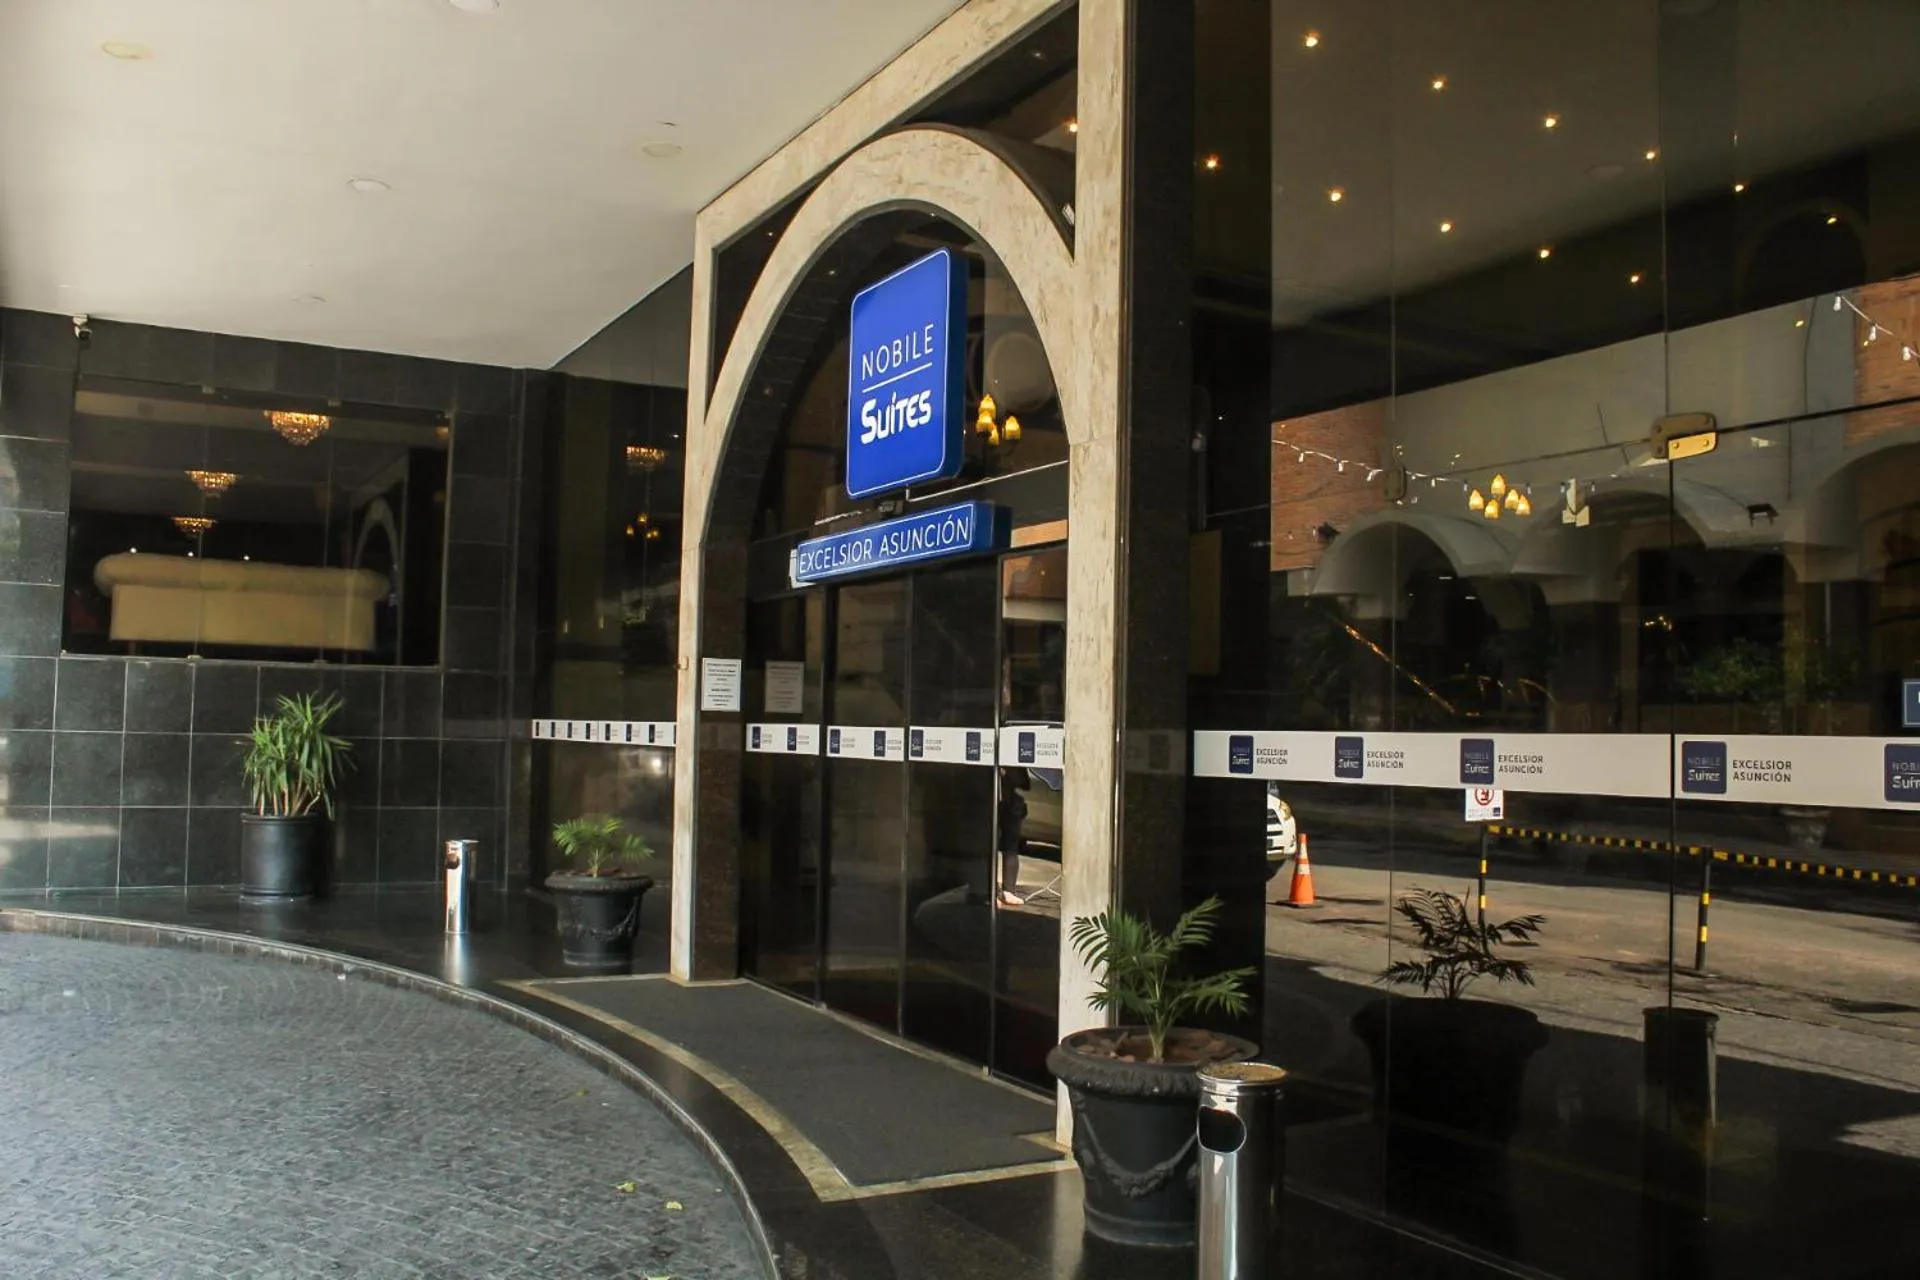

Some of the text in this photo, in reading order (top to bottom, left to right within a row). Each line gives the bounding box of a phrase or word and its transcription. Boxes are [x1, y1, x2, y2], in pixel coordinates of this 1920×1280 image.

[861, 323, 934, 381] NOBILE
[799, 514, 969, 573] EXCELSIOR ASUNCIÓN
[1366, 751, 1405, 759] EXCELSIOR
[1498, 754, 1544, 764] EXCELSIOR
[1498, 763, 1543, 774] ASUNCIÓN
[1732, 759, 1792, 770] EXCELSIOR
[1732, 770, 1792, 783] ASUNCIÓN
